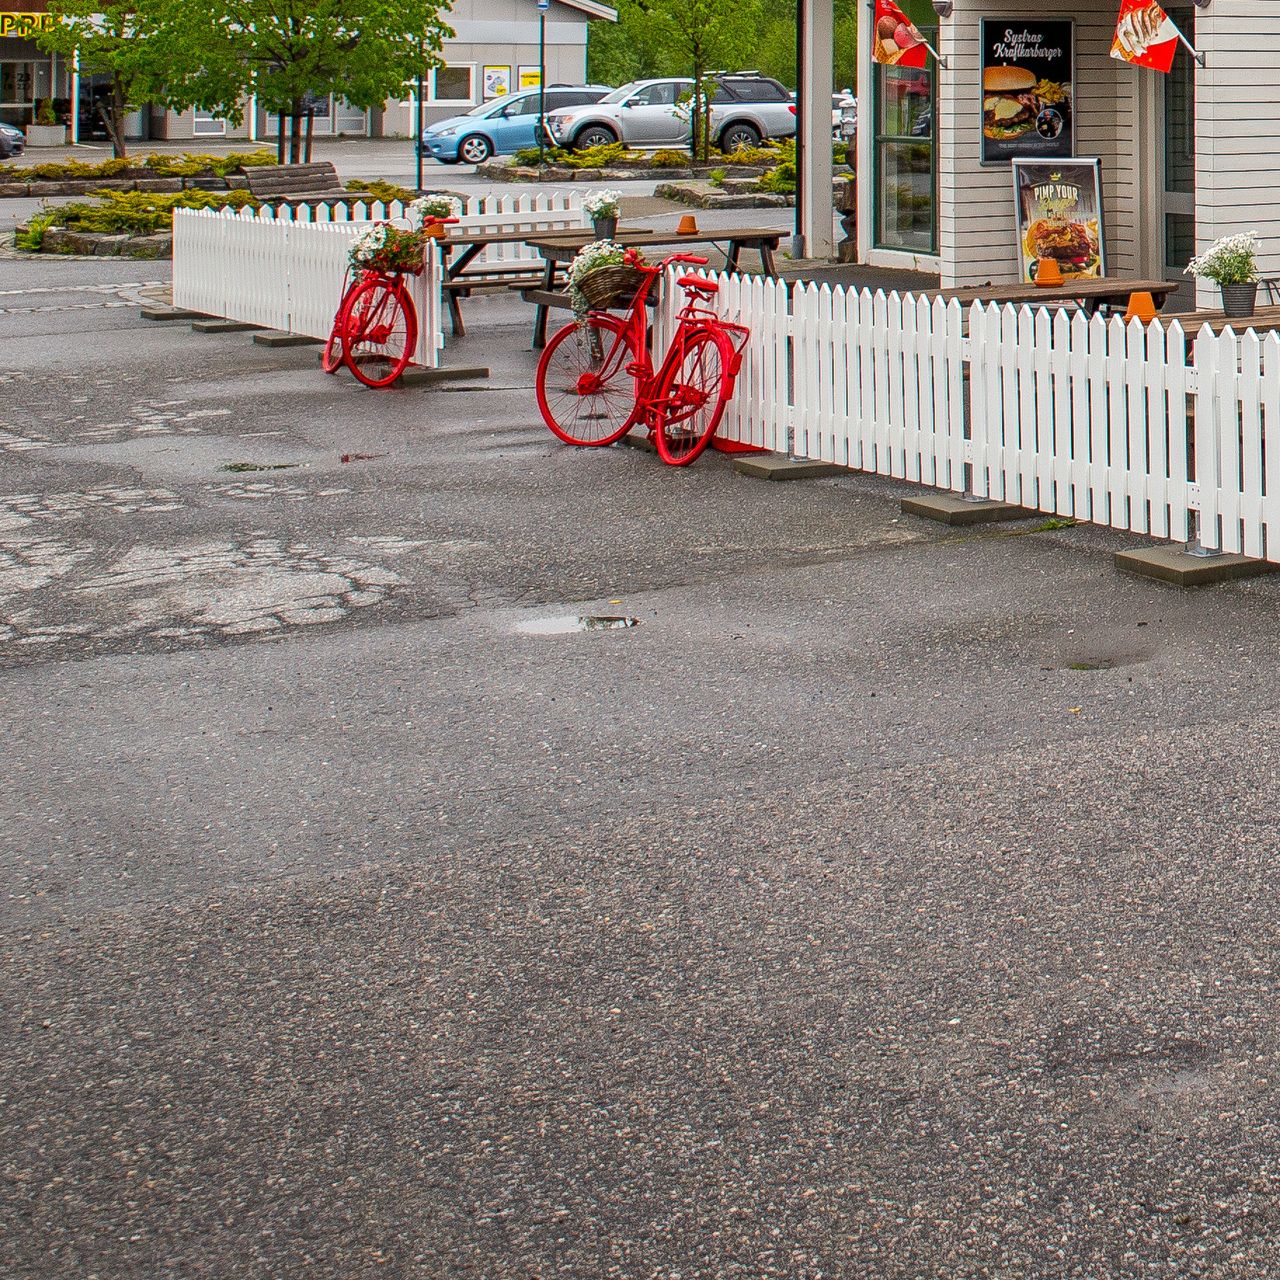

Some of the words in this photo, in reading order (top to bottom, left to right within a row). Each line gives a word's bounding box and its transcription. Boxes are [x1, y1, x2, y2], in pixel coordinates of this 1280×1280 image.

[1004, 29, 1044, 46] Systras
[993, 43, 1063, 61] Kraftkarburger
[1034, 185, 1055, 200] PIMP
[1056, 185, 1079, 200] YOUR
